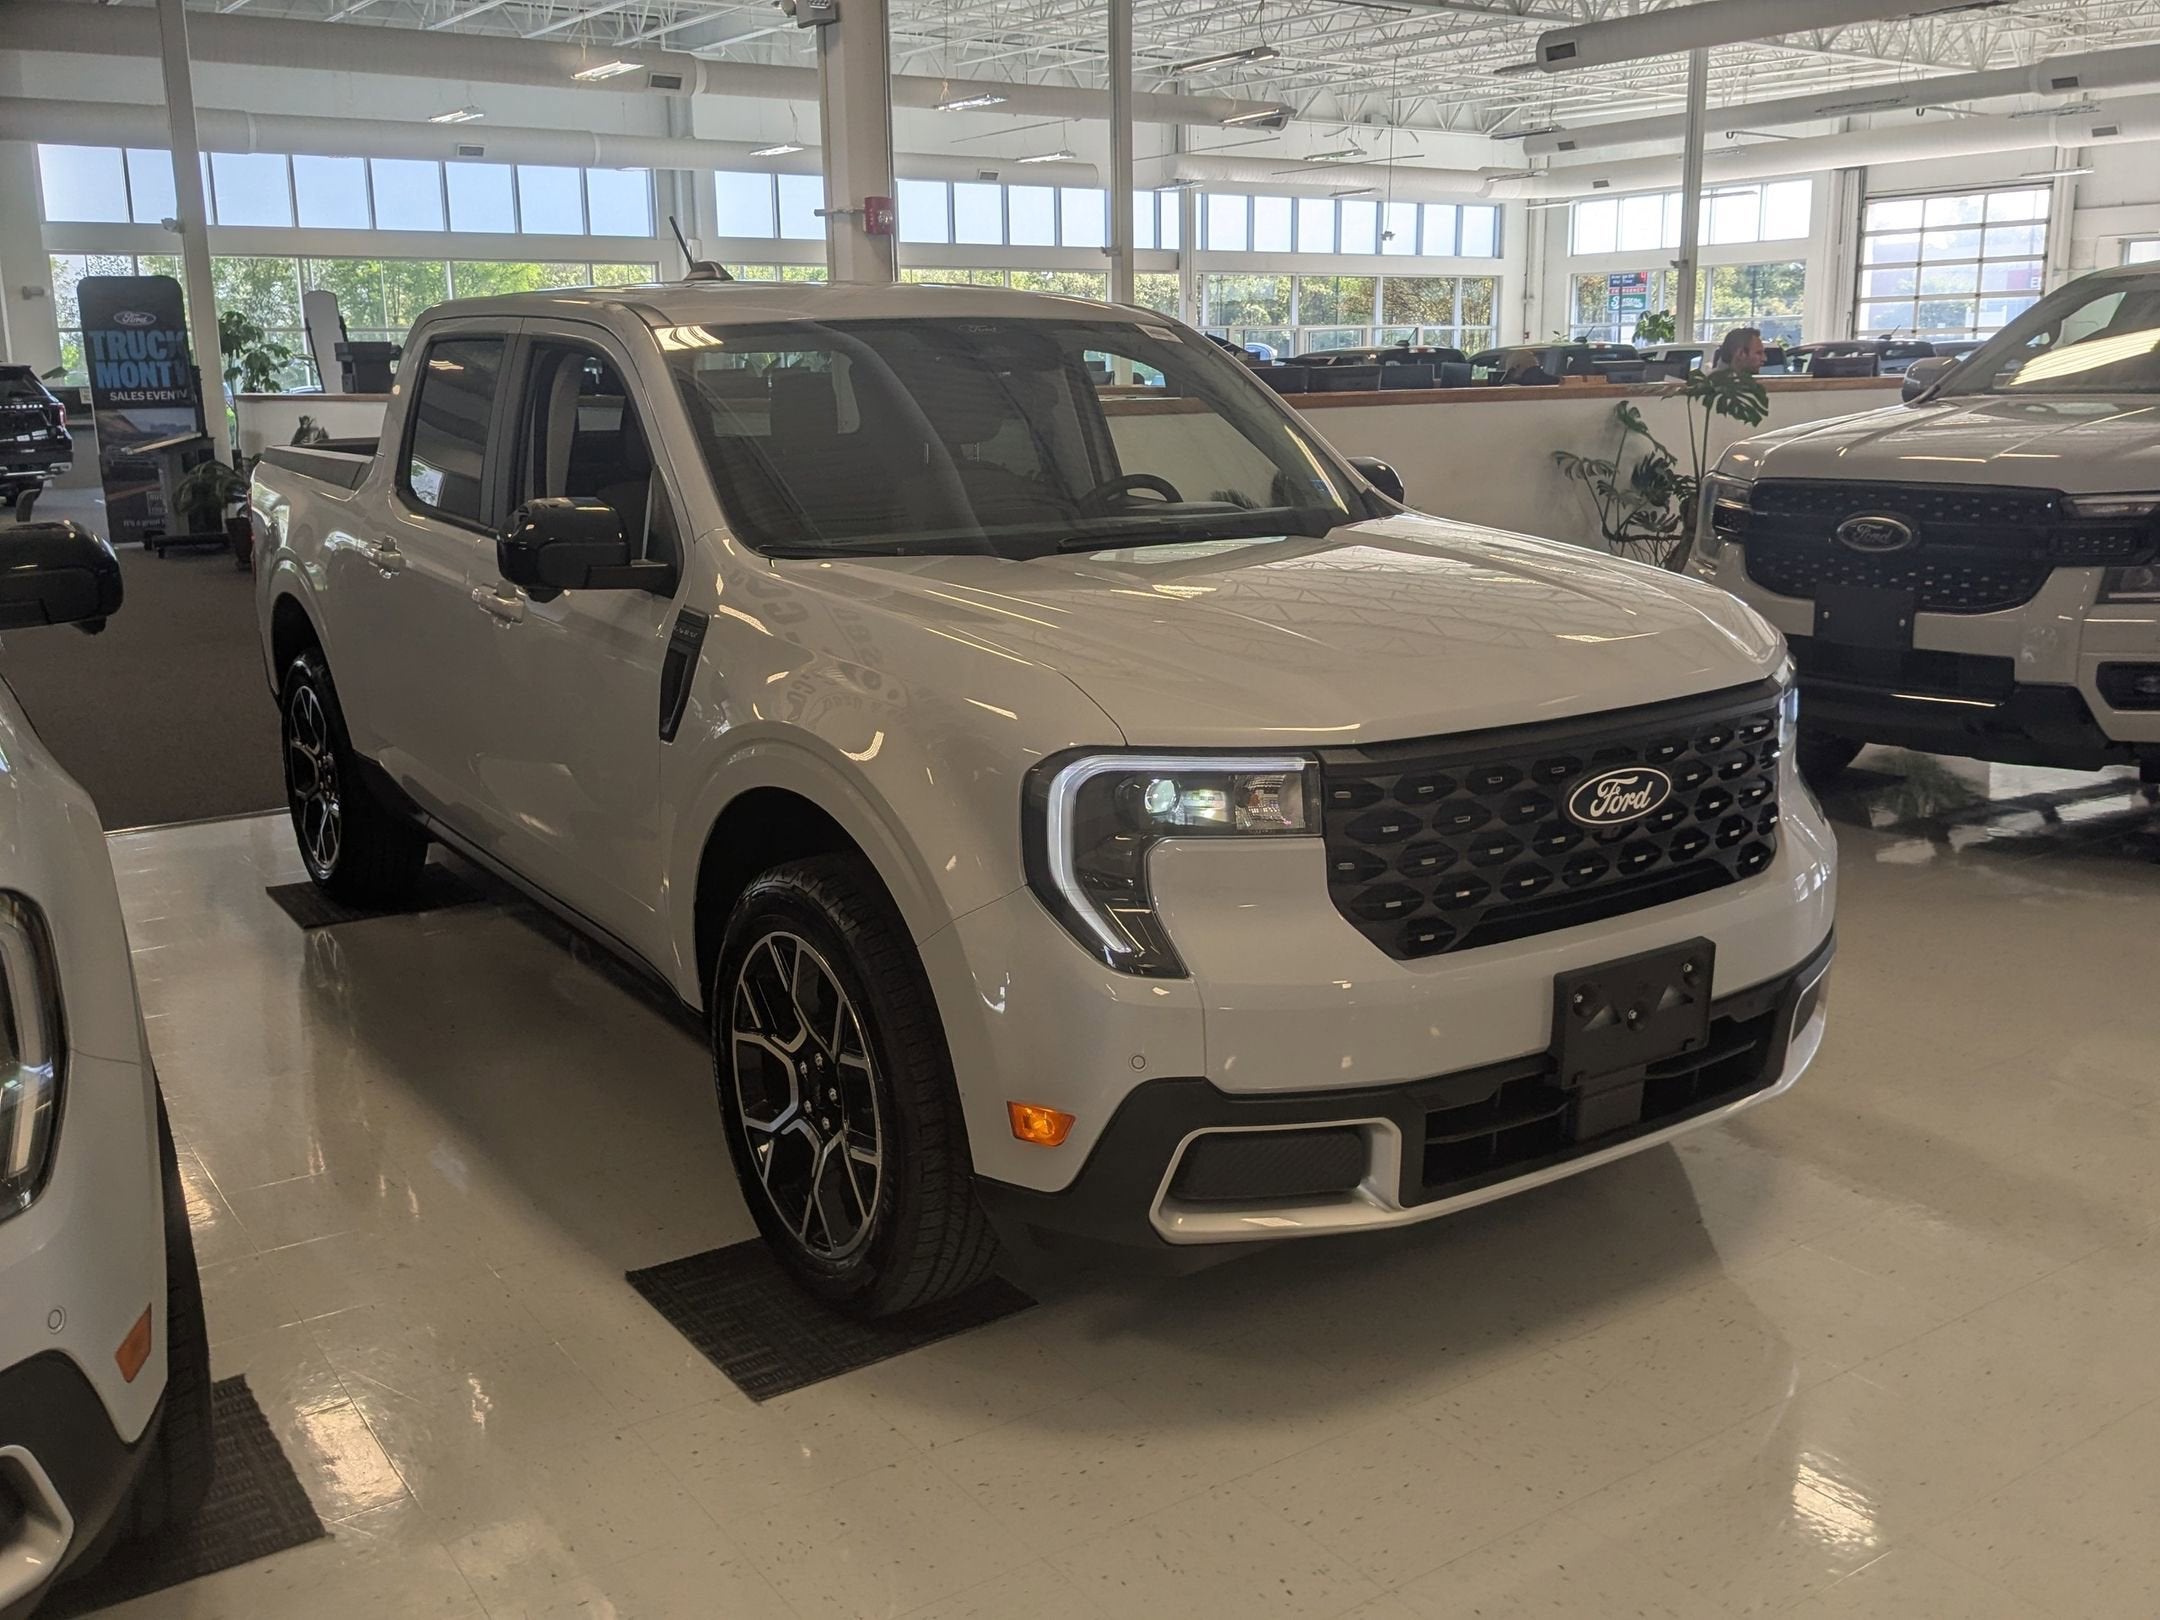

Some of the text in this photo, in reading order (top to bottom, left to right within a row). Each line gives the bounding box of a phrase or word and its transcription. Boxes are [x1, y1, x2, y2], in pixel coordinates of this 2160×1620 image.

[110, 391, 145, 401] SALES
[1852, 523, 1894, 544] Ford
[1590, 775, 1654, 817] Ford
